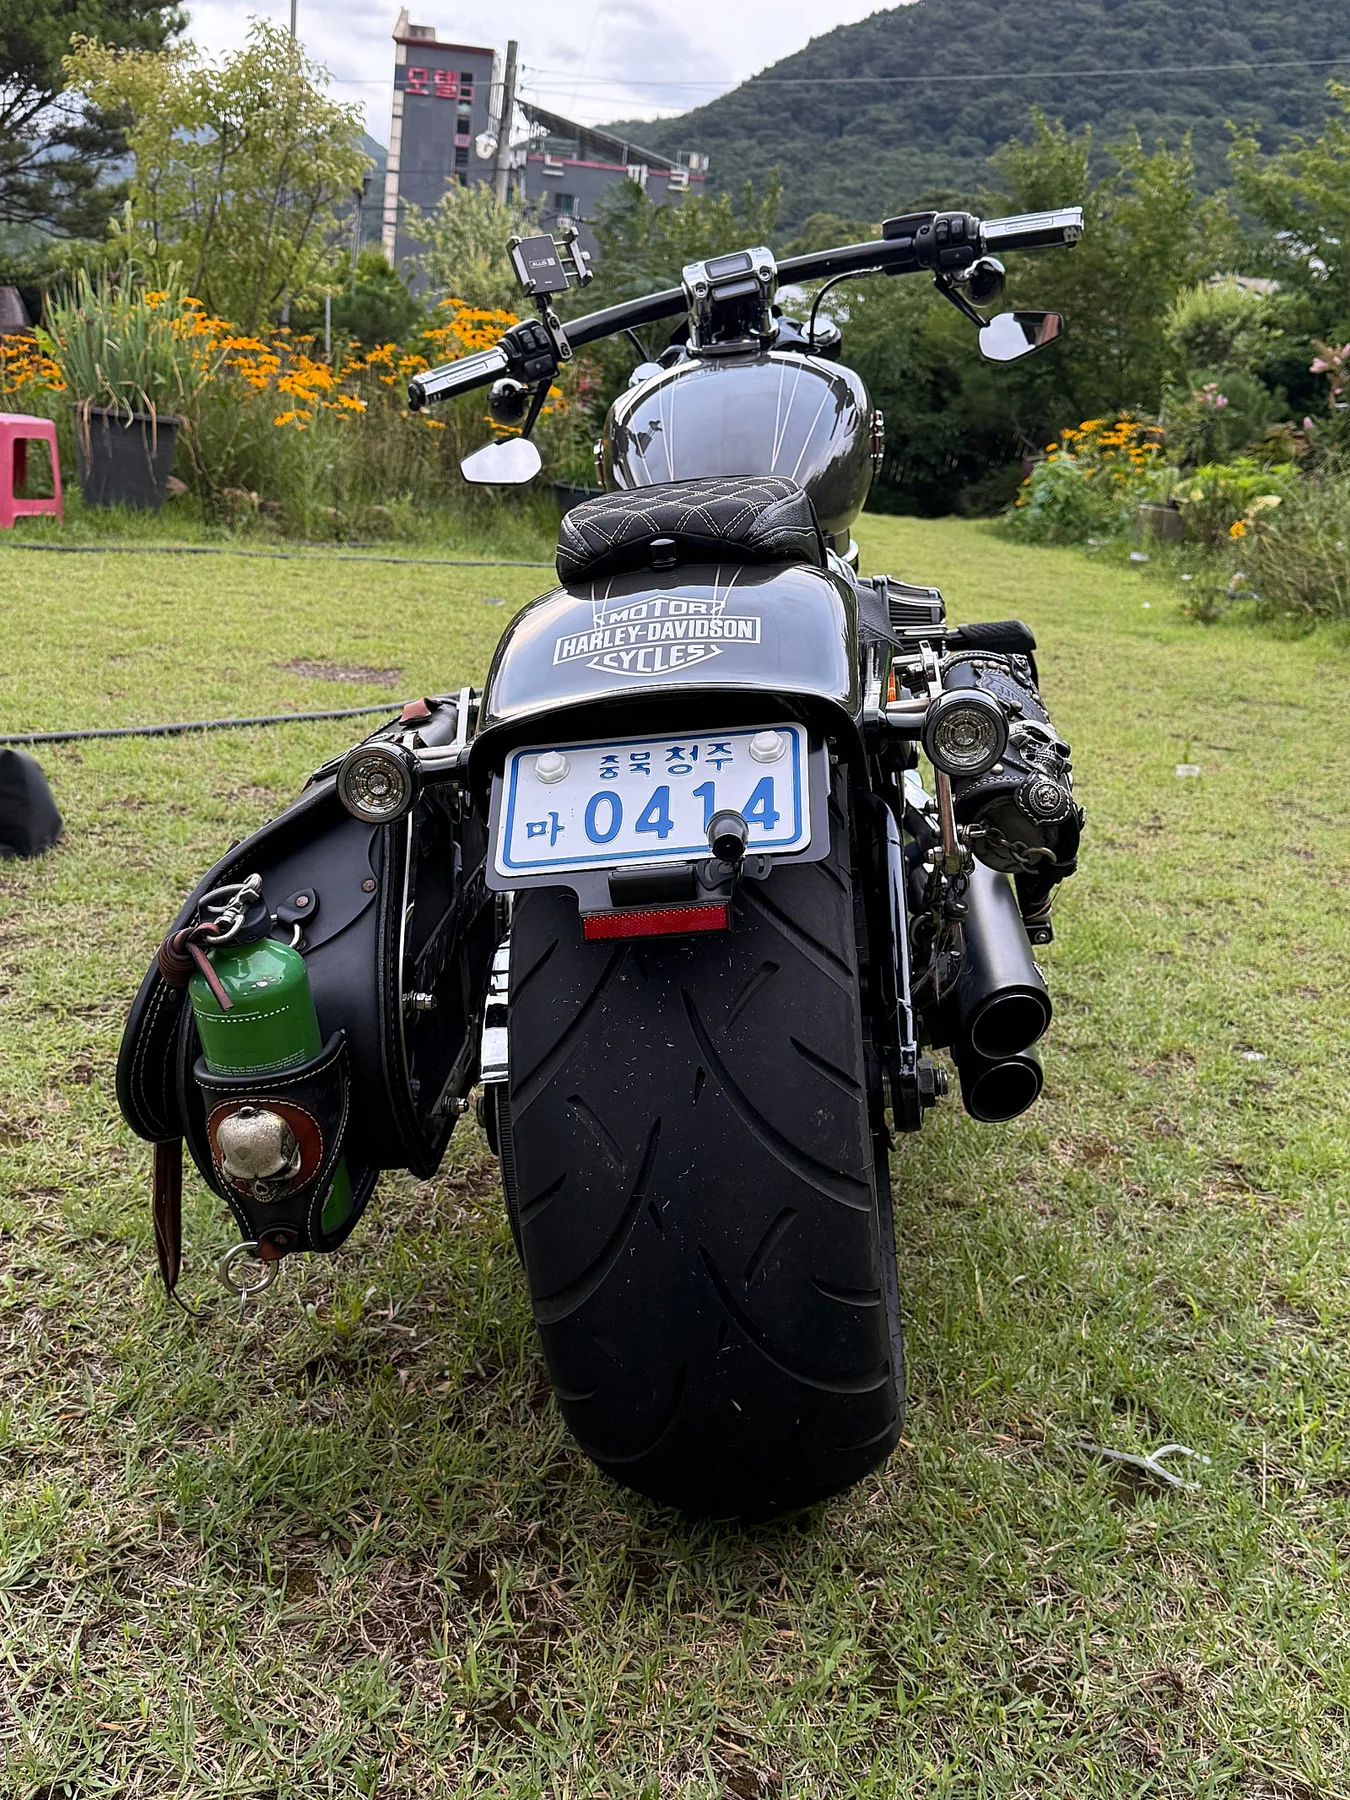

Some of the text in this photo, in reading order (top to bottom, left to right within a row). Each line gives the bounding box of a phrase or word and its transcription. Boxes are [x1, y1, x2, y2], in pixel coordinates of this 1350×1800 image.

[405, 67, 457, 98] 모텔
[626, 164, 690, 193] 파크
[609, 599, 707, 623] MOTOR
[561, 619, 752, 658] HARLEY-DAVIDSON
[603, 644, 706, 672] CYCLES
[599, 742, 734, 779] 충북 청주
[525, 775, 780, 847] 마 0414
